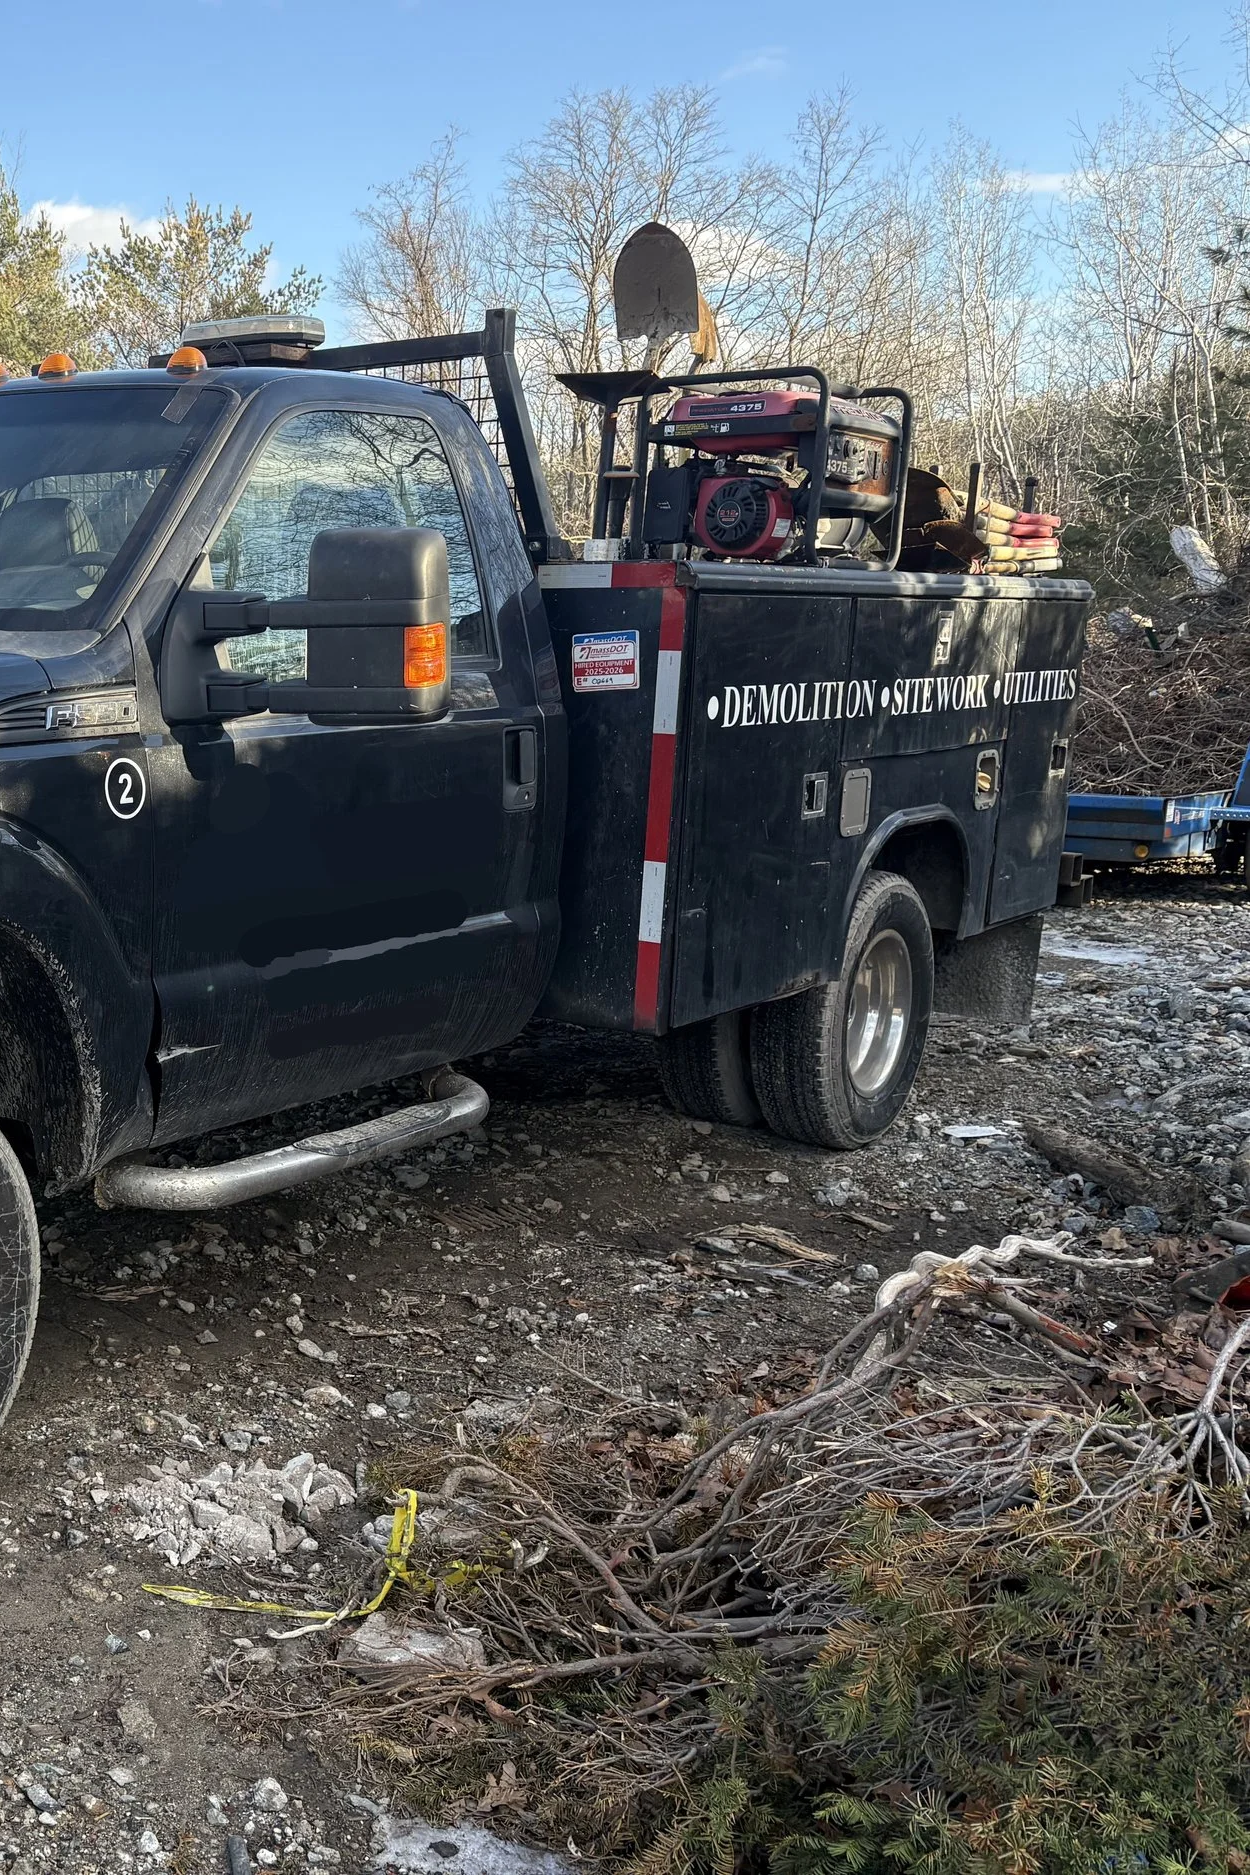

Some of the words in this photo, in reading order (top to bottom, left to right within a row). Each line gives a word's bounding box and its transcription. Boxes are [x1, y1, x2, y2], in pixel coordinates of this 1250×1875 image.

[730, 403, 762, 412] 4375
[591, 645, 628, 654] massDOT
[595, 660, 633, 668] EQUIPMENT
[585, 667, 624, 675] 2025-2026
[721, 679, 878, 728] DEMOLITION
[1003, 668, 1078, 706] UTILITIES
[118, 773, 134, 805] 2
